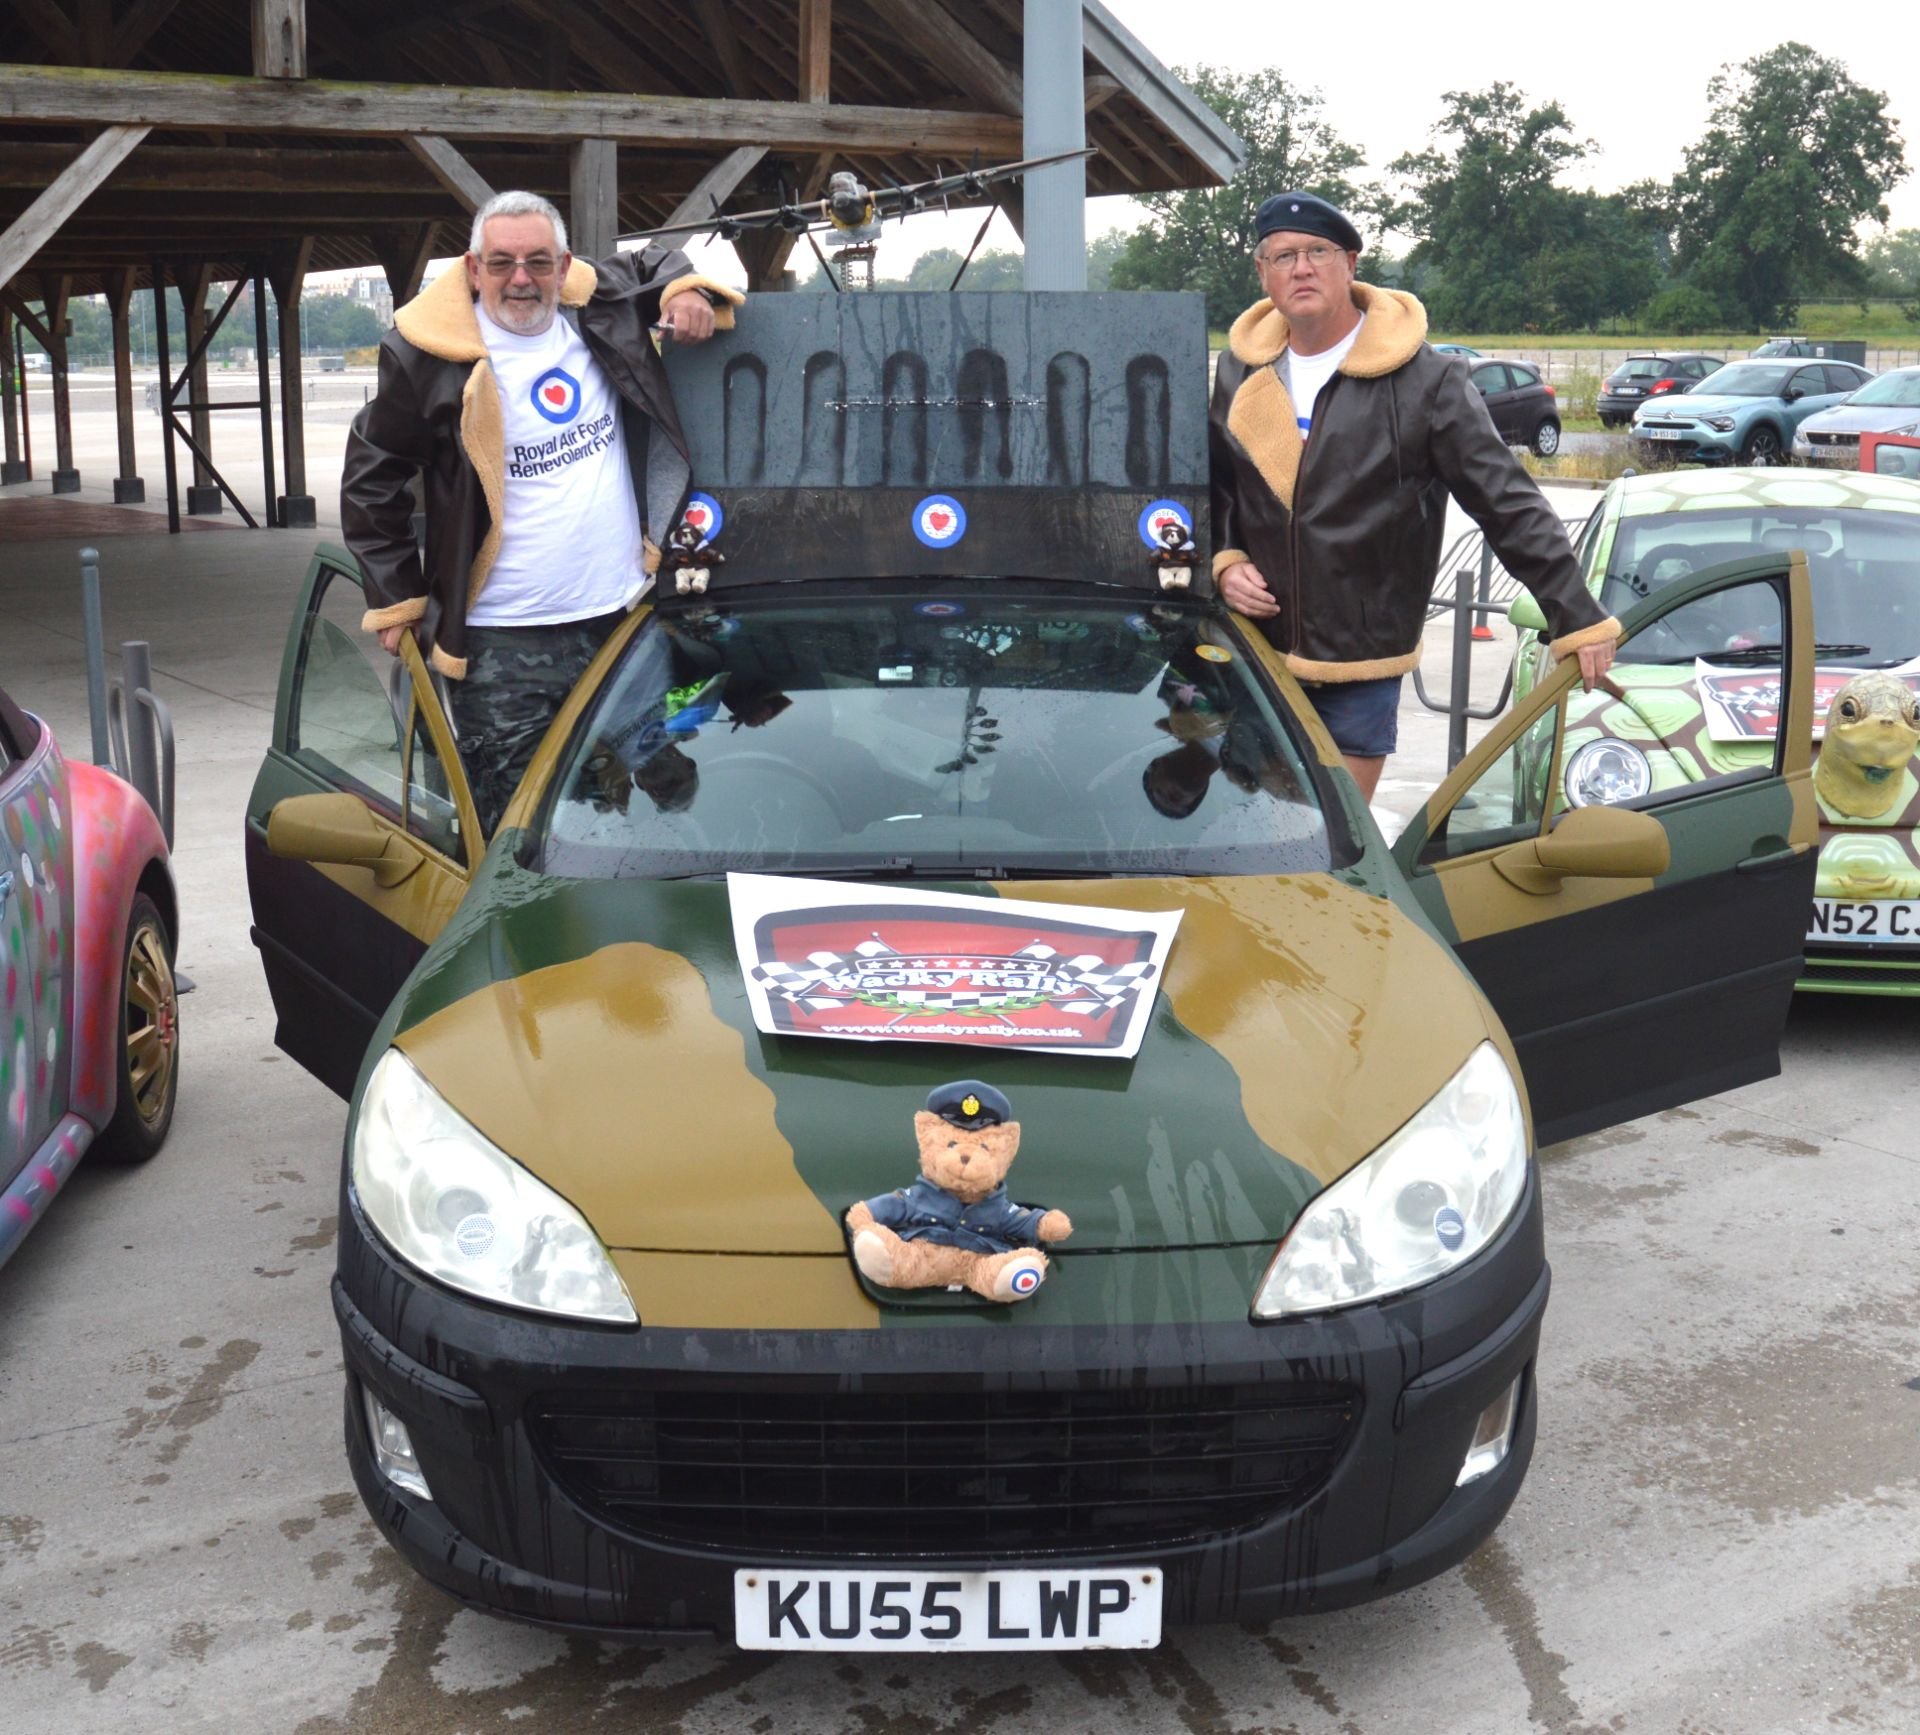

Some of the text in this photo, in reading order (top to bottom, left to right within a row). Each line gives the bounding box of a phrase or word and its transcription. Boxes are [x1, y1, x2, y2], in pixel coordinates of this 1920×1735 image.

[513, 413, 613, 463] Royal Air Force
[509, 440, 594, 478] Benevolent
[1889, 905, 1920, 936] C
[828, 969, 1083, 995] Wacky Rally
[821, 1024, 1083, 1038] www.wackyrally.co.uk
[768, 1579, 1131, 1640] KU55 LWP
